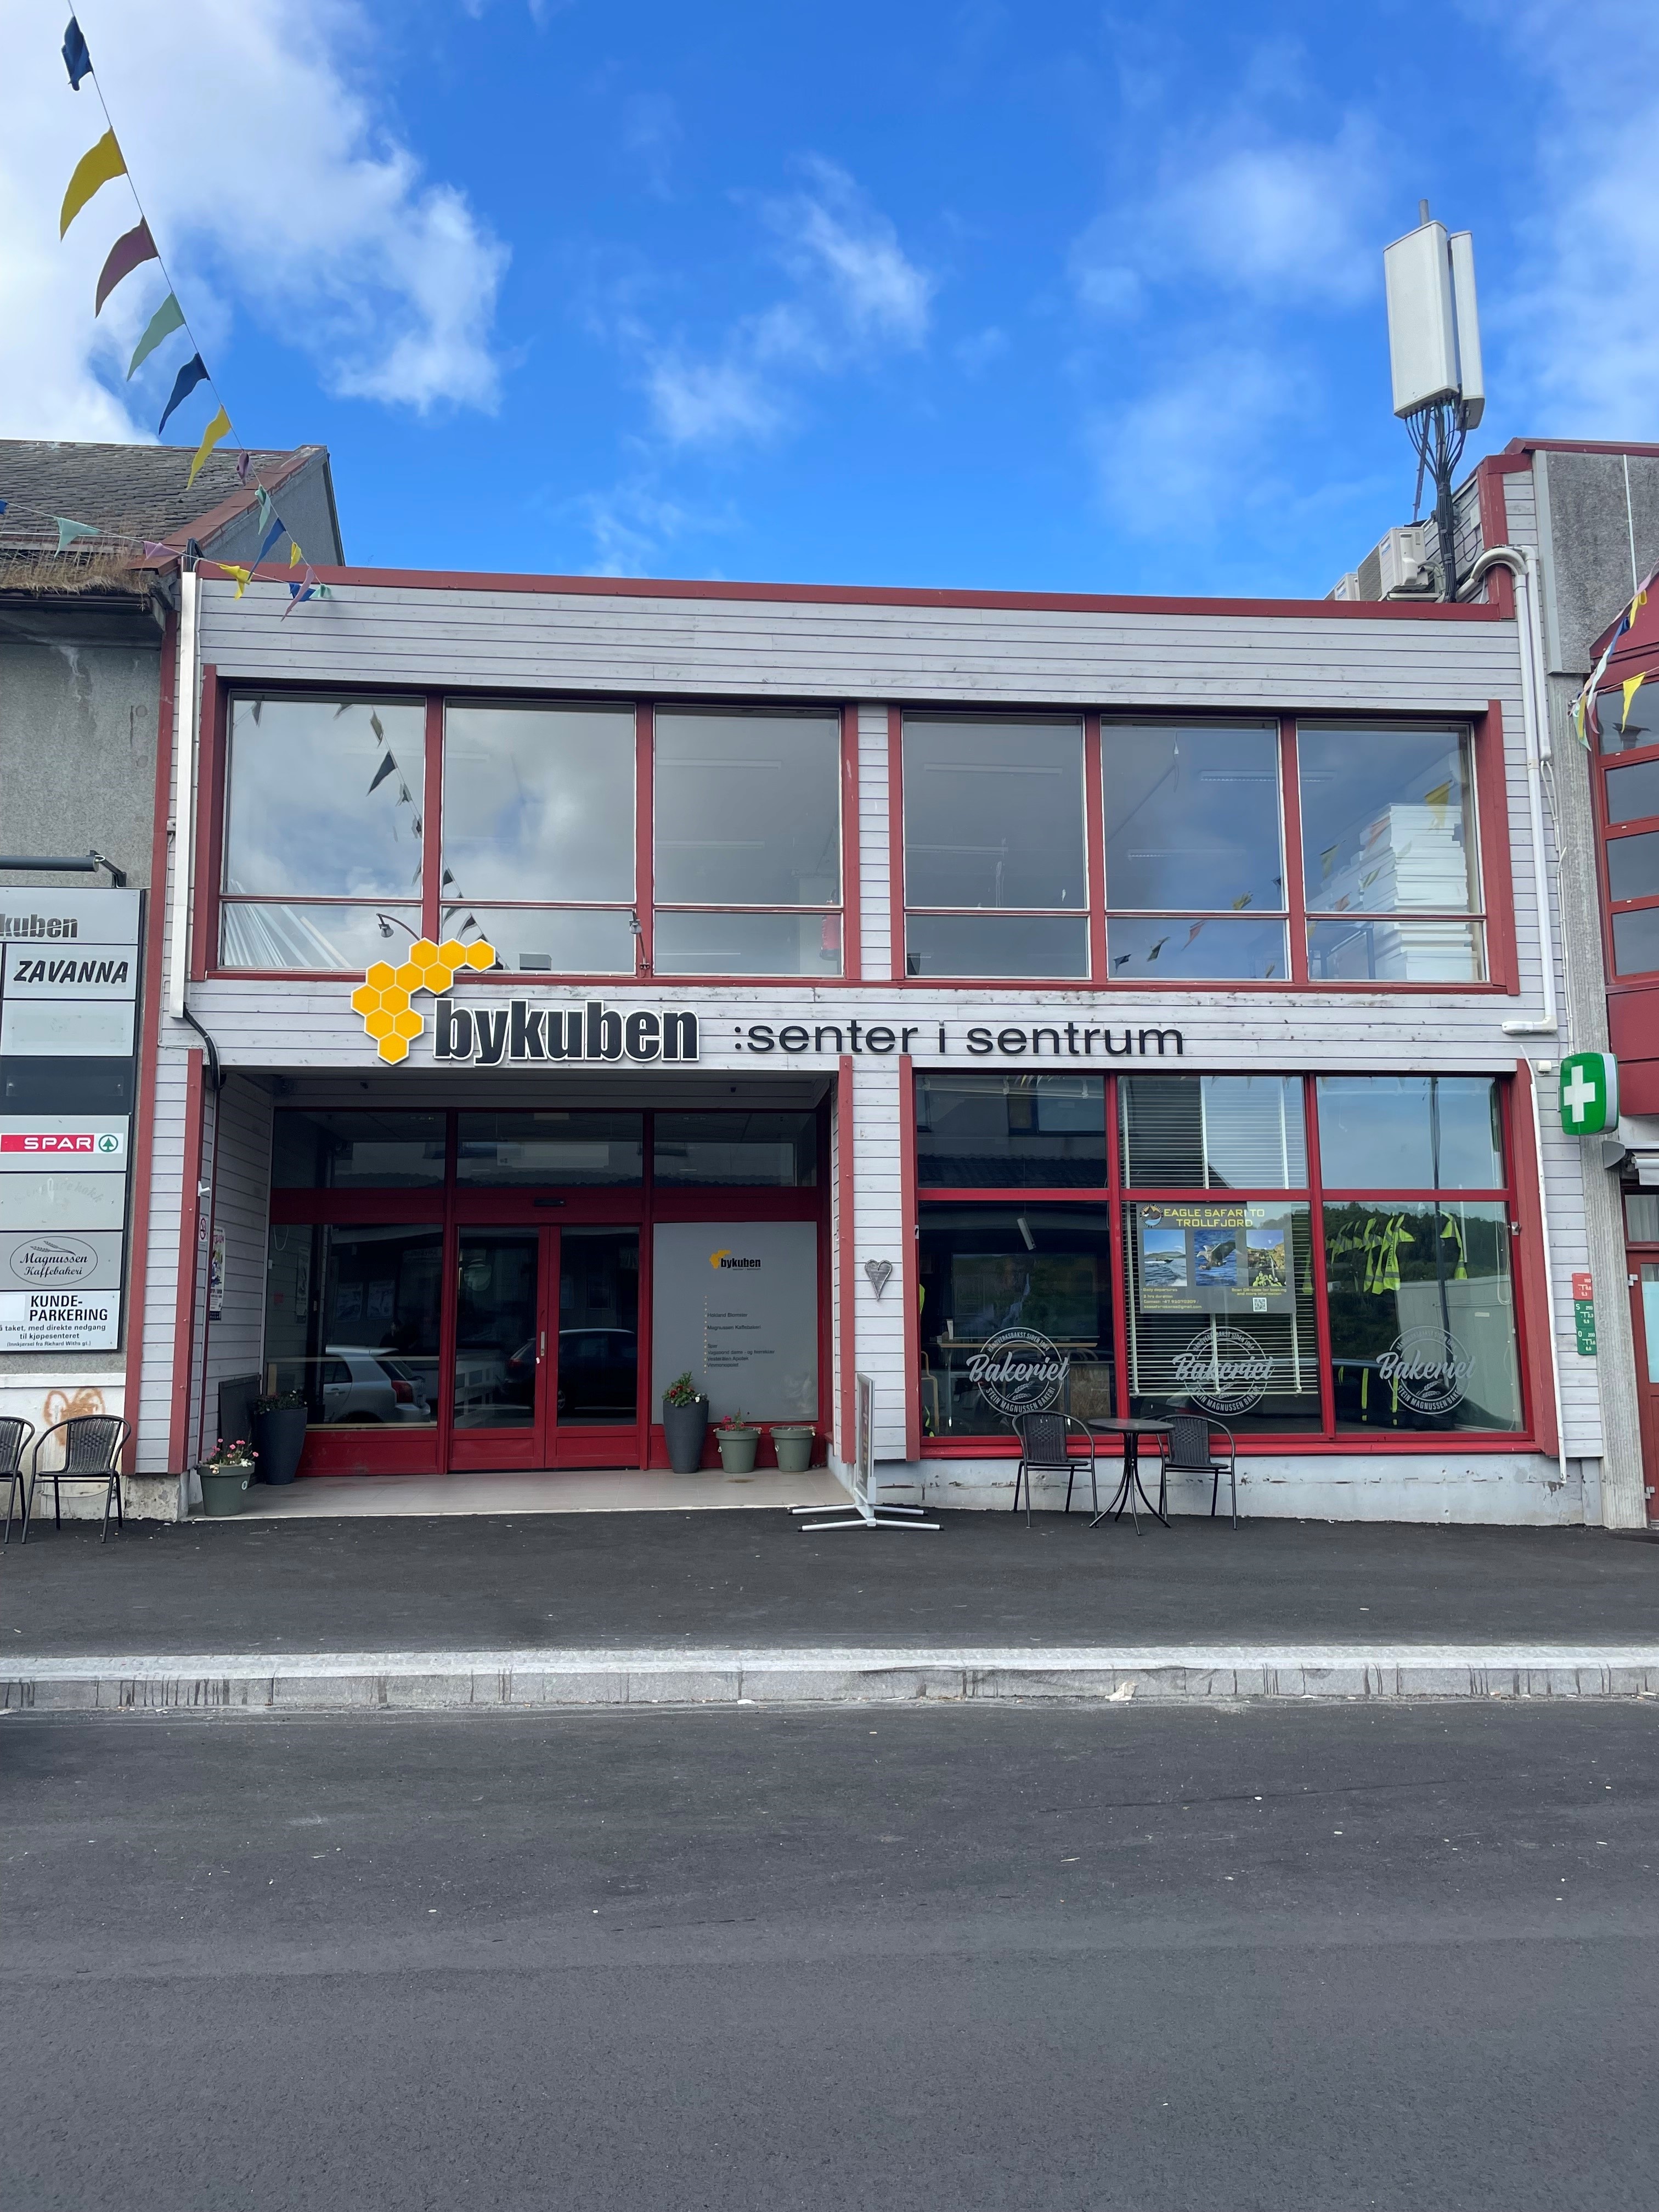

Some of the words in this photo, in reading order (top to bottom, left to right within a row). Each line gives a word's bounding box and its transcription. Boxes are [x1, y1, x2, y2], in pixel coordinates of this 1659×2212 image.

[13, 960, 128, 984] ZAVANNA
[434, 998, 699, 1066] bykuben
[735, 1020, 918, 1053] :senter
[939, 1020, 945, 1053] i
[967, 1022, 1184, 1054] sentrum
[24, 1137, 92, 1150] SPAR
[1164, 1209, 1201, 1217] EAGLE
[1204, 1209, 1246, 1217] SAFARI
[1249, 1209, 1265, 1217] TO
[1176, 1218, 1253, 1227] TROLLFJORD
[20, 1252, 88, 1267] Magnussen
[720, 1257, 761, 1268] bykuben
[24, 1266, 83, 1278] Kaffebakeri
[31, 1295, 83, 1307] KUNDE-
[30, 1309, 108, 1321] PARKERING
[1026, 1333, 1041, 1344] SIDEN
[966, 1351, 1070, 1382] Bakeriet
[1172, 1352, 1276, 1381] Bakeriet
[1376, 1350, 1476, 1380] Bakeriet
[985, 1387, 1001, 1404] STEIN
[1000, 1401, 1039, 1413] MAGNUSSEN
[1037, 1386, 1056, 1407] BAKERI
[1398, 1385, 1411, 1402] STEIN
[1410, 1398, 1448, 1410] MAGNUSSEN
[1206, 1399, 1244, 1412] MAGNUSSEN
